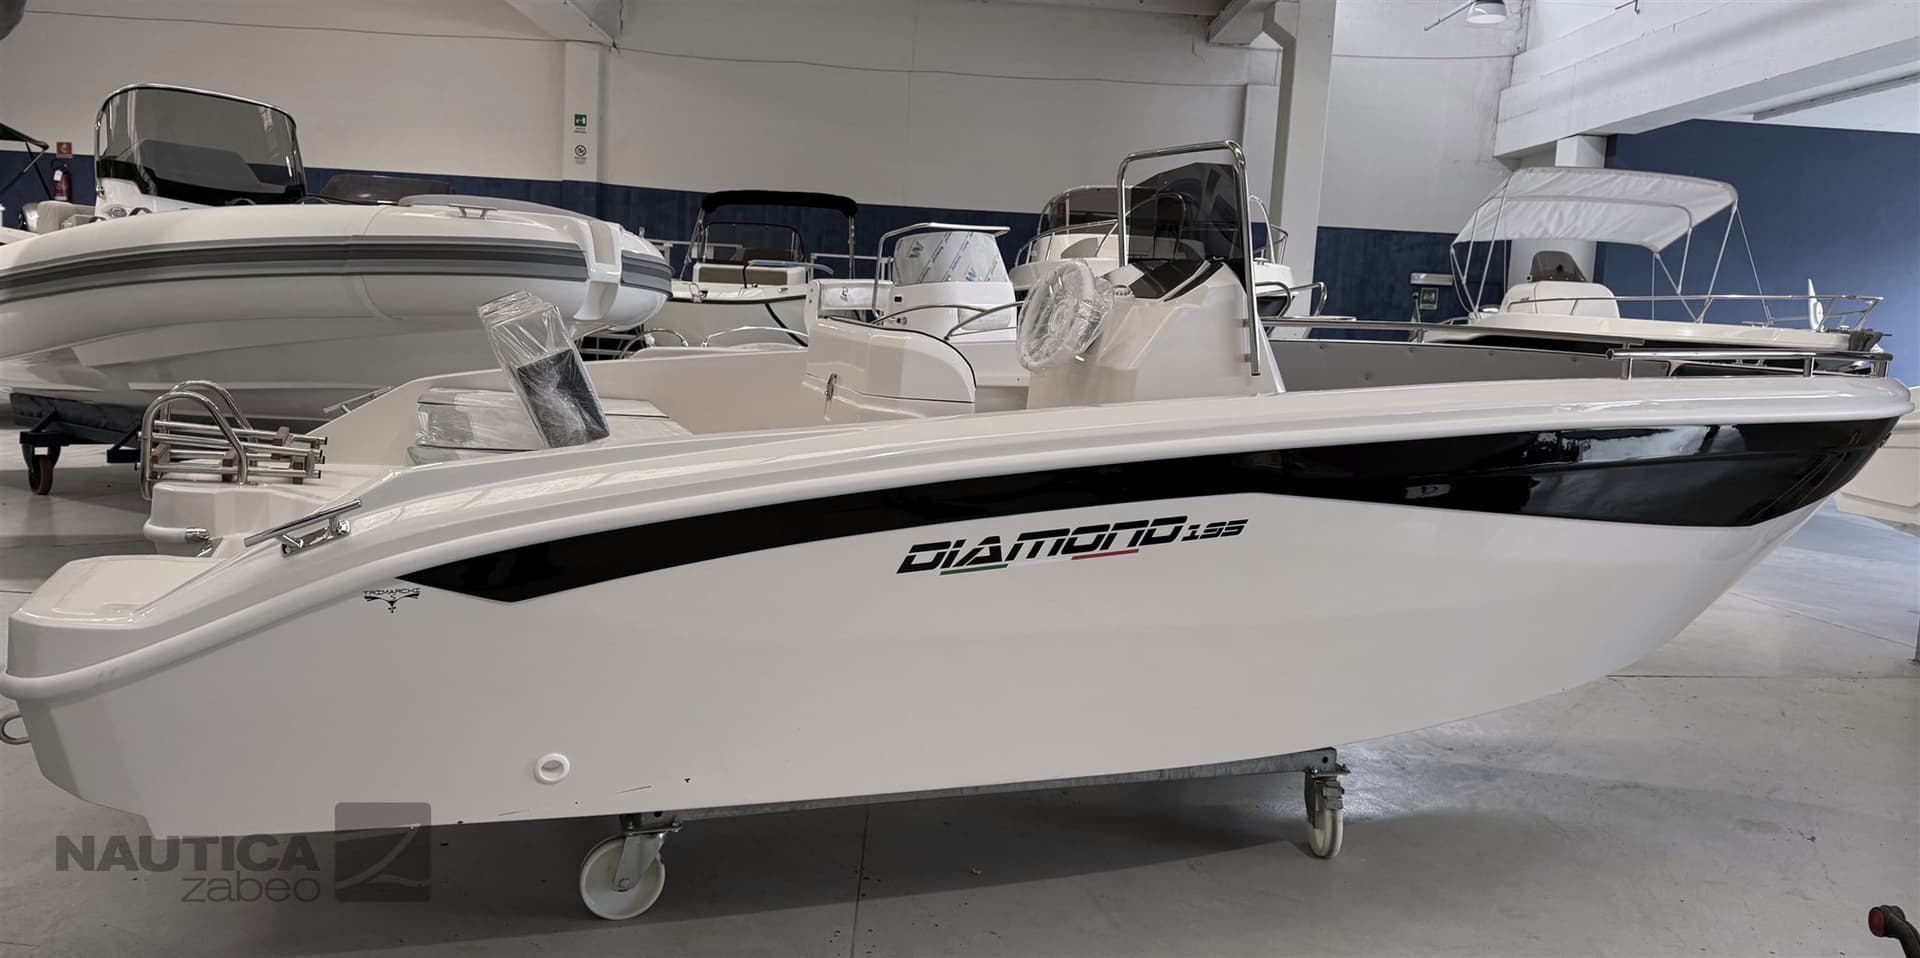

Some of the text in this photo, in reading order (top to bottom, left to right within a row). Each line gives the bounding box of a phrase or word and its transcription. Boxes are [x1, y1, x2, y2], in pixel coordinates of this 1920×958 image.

[896, 515, 1249, 574] DIAMOND 195
[362, 587, 421, 596] TRIMARCHI
